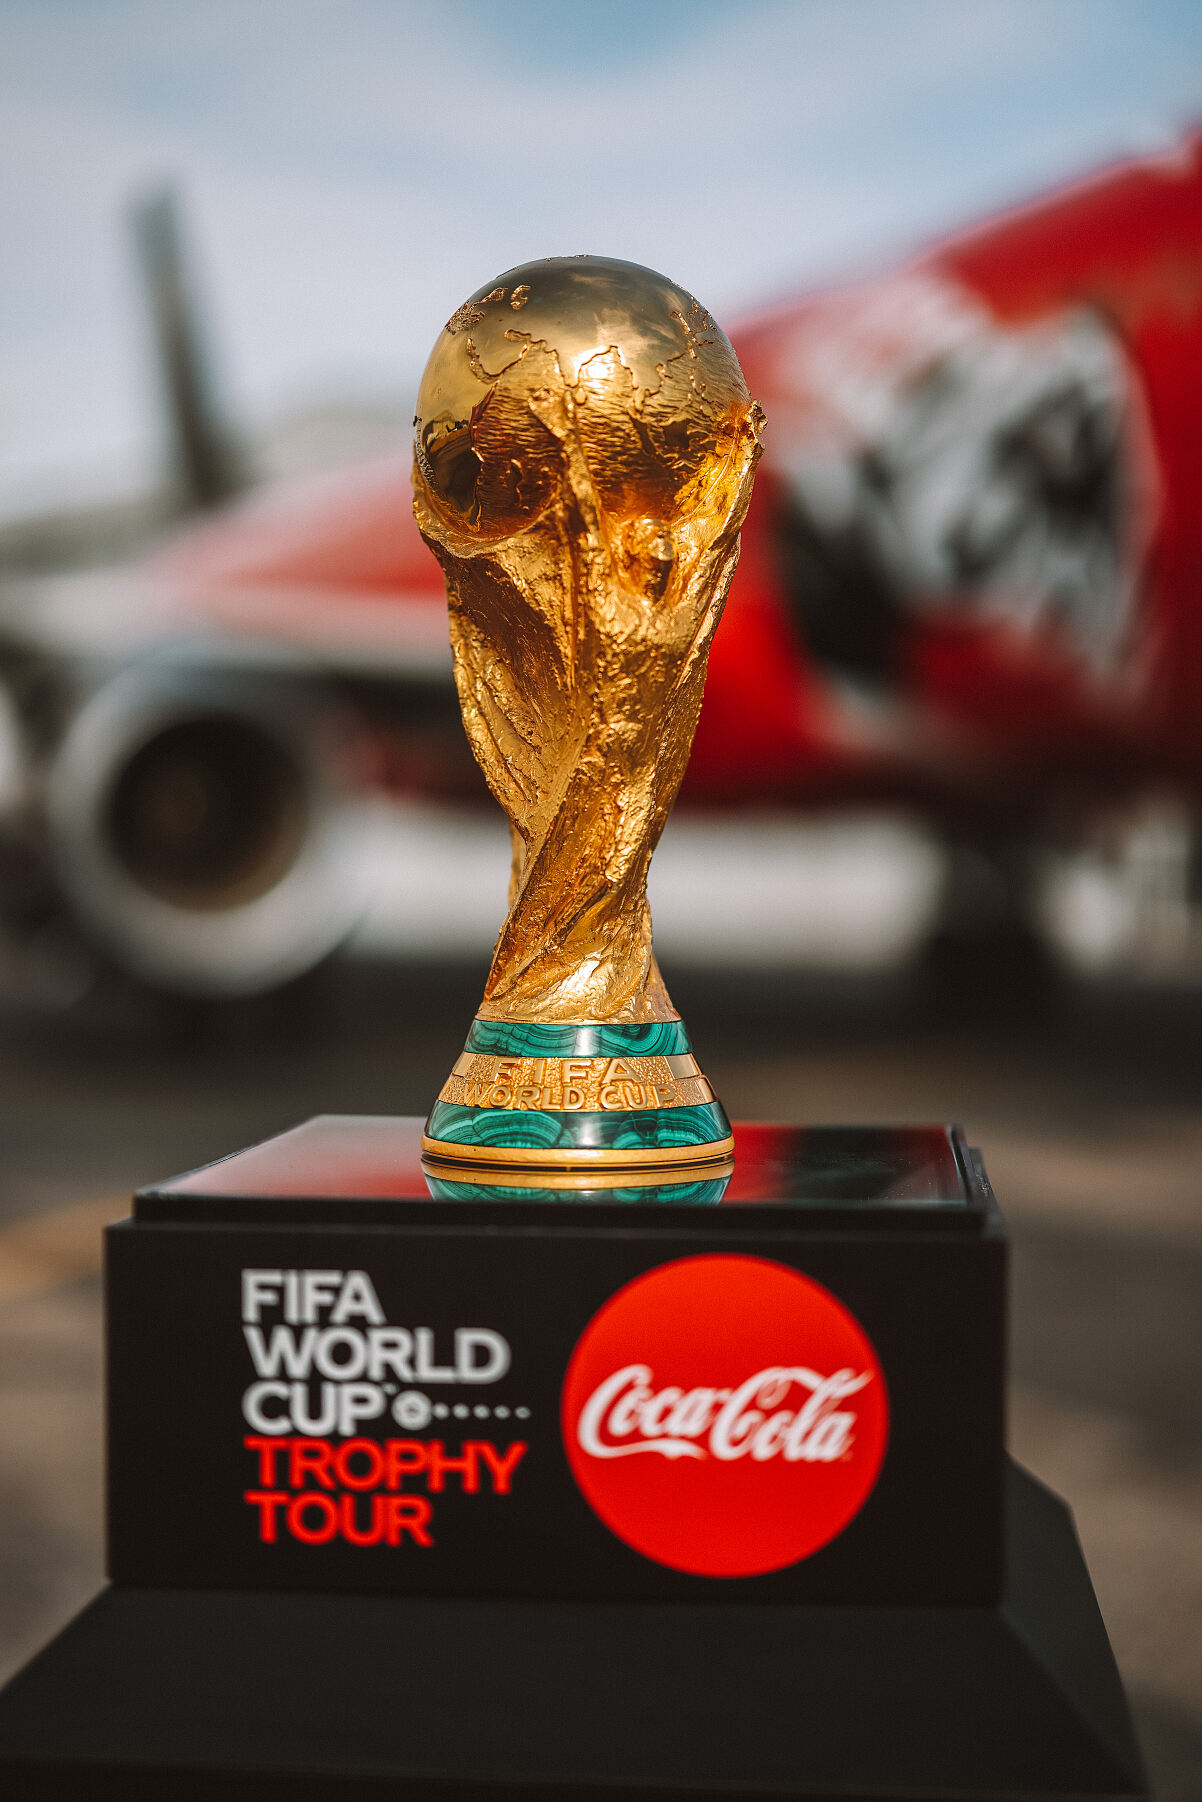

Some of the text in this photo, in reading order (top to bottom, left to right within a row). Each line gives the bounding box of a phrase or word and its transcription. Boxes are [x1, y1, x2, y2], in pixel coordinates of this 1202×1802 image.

[464, 1083, 676, 1111] WORLD CUP
[490, 1057, 644, 1085] FIFA
[241, 1268, 387, 1326] FIFA
[243, 1325, 512, 1385] WORLD
[241, 1380, 388, 1437] CUP
[577, 1363, 875, 1463] Coca-Cola
[244, 1436, 528, 1494] TROPHY
[244, 1490, 434, 1547] TOUR
